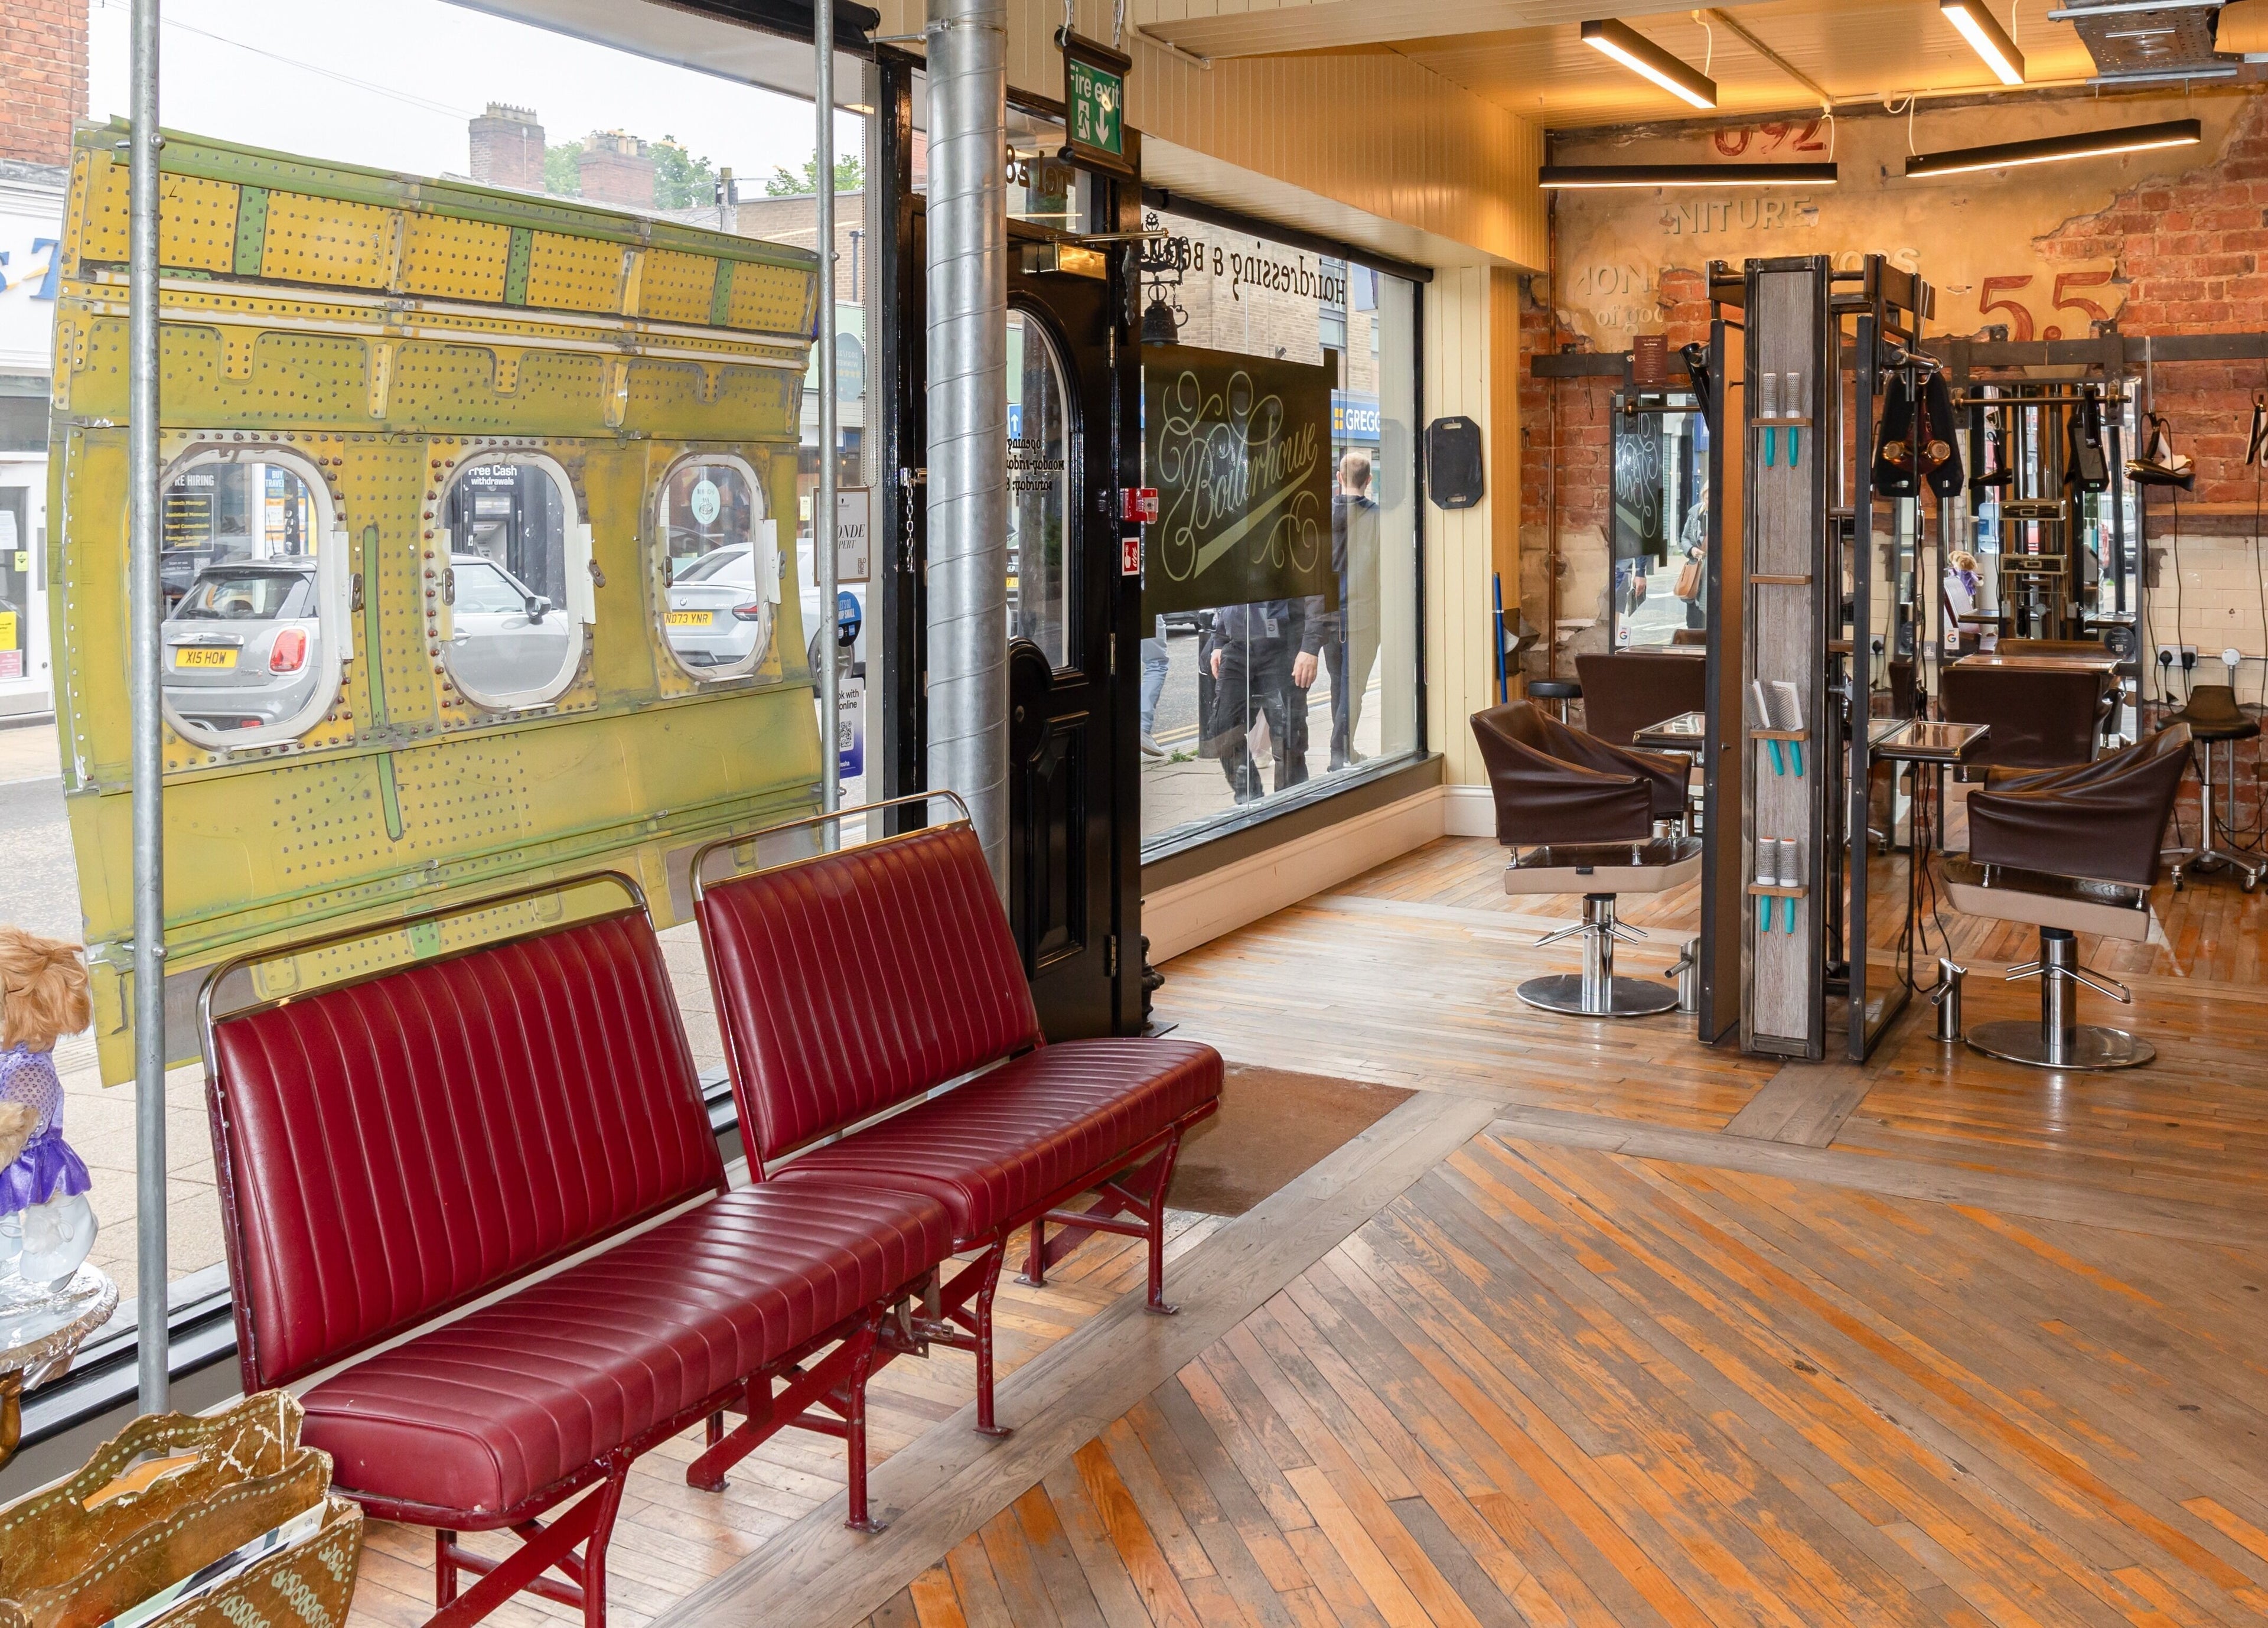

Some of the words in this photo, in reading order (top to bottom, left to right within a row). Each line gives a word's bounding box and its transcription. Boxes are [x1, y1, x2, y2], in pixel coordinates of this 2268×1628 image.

[1094, 81, 1120, 109] exit
[272, 470, 284, 479] BUY
[493, 464, 517, 476] Cash
[187, 475, 214, 486] HIRING
[471, 477, 514, 485] withdrawals
[665, 614, 689, 624] ND73
[691, 614, 709, 624] YNR
[186, 651, 202, 664] X15
[204, 652, 226, 665] HOW
[846, 688, 859, 698] with
[839, 701, 858, 710] online
